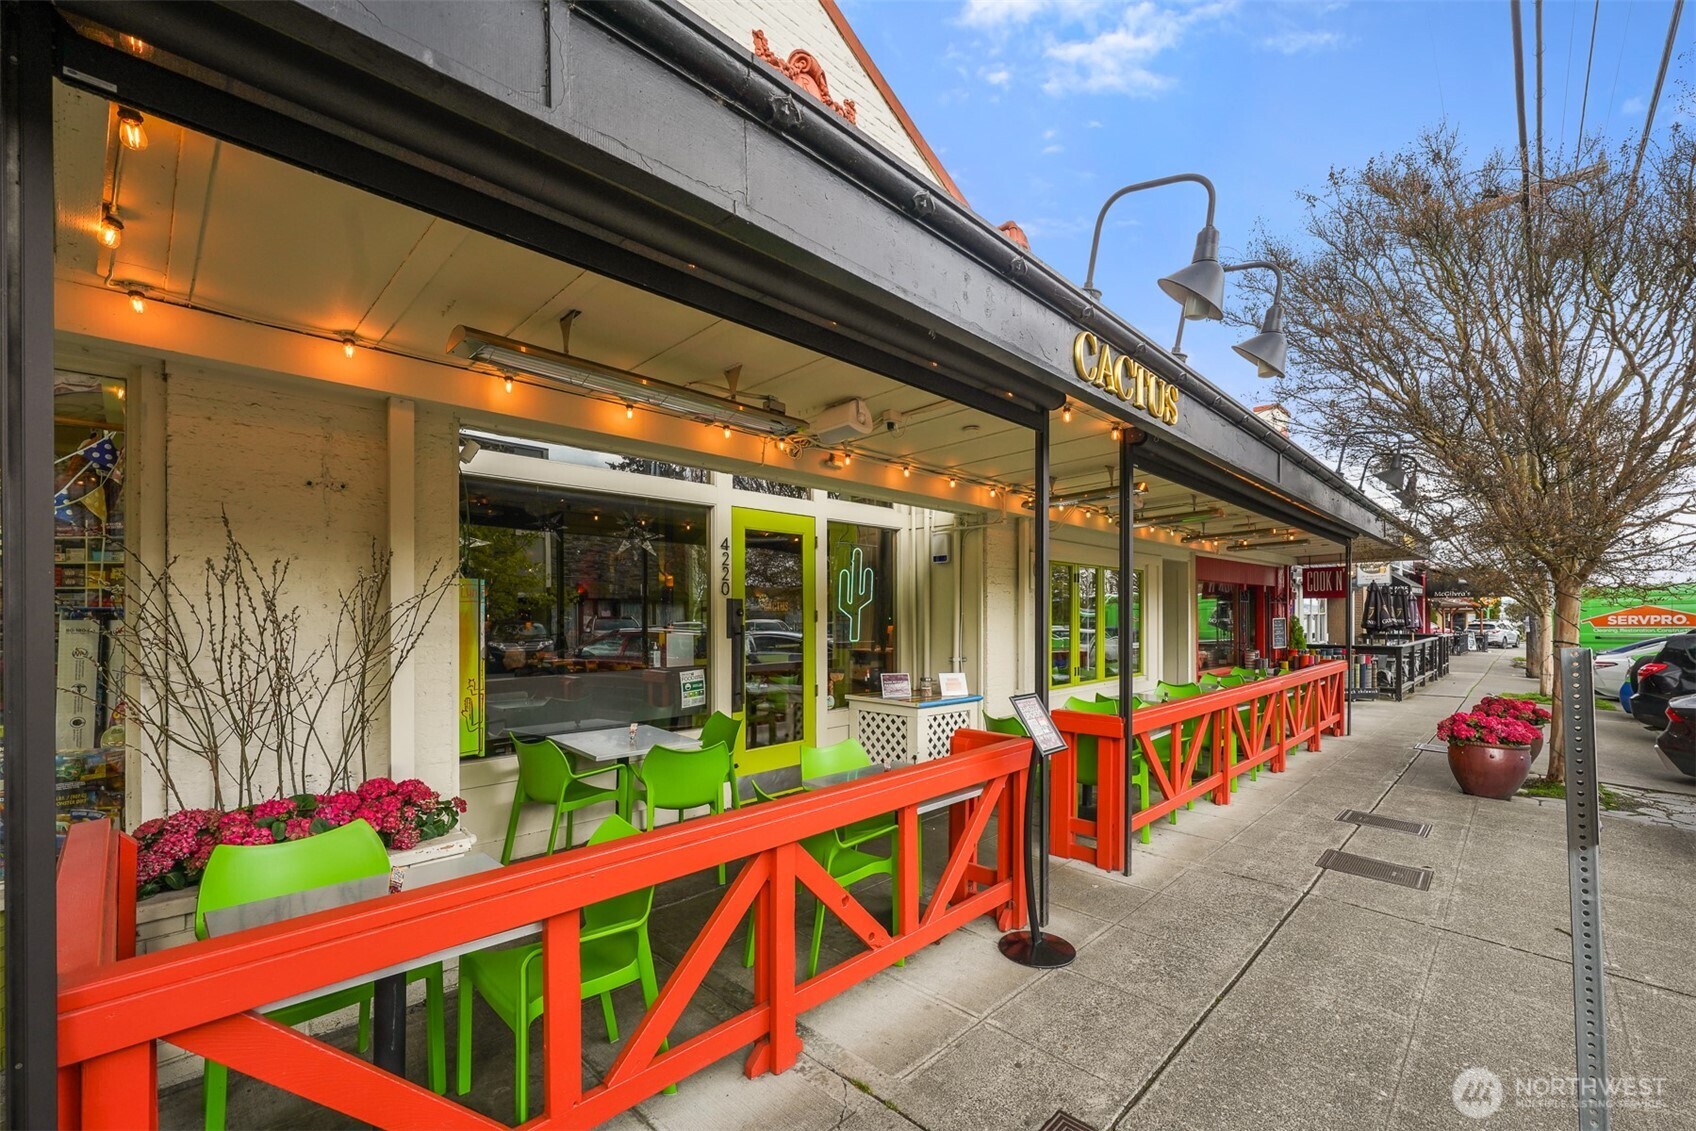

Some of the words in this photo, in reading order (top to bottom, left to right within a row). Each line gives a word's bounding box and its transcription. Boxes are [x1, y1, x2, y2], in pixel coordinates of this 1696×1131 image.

[1073, 331, 1179, 425] CACTUS
[720, 537, 730, 596] 4220
[1307, 571, 1333, 591] COOK
[1336, 568, 1345, 591] N'
